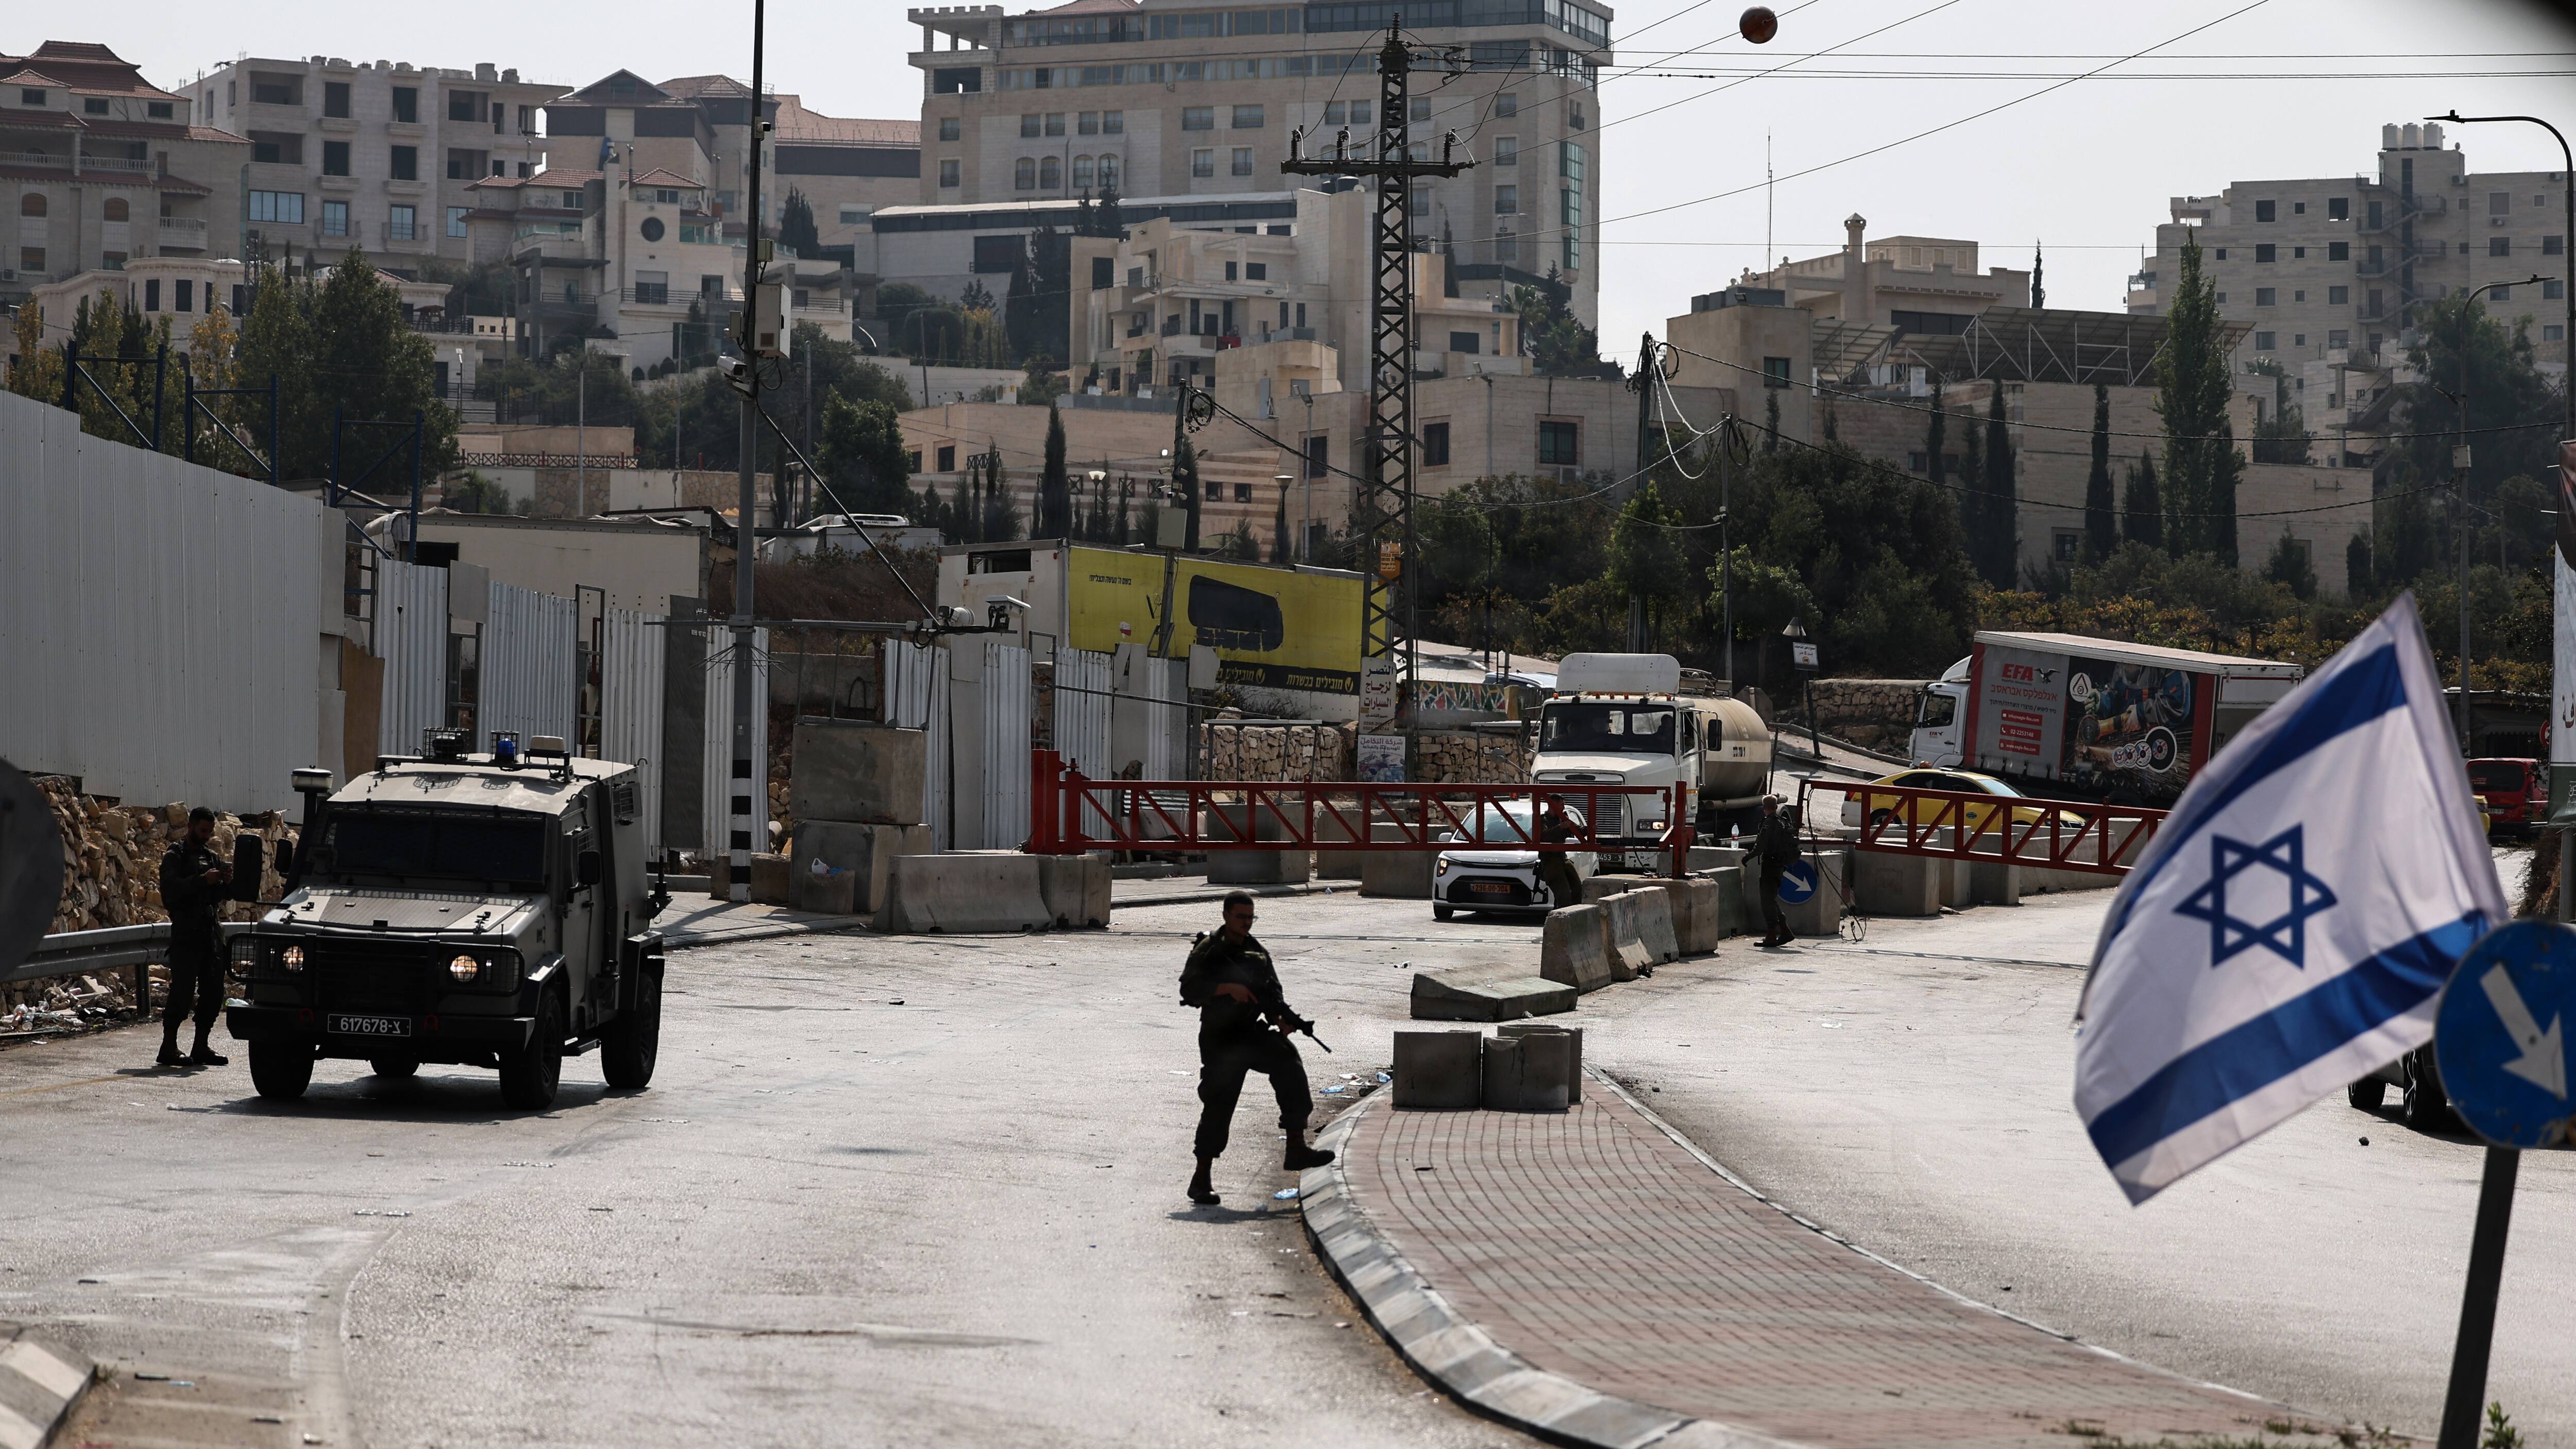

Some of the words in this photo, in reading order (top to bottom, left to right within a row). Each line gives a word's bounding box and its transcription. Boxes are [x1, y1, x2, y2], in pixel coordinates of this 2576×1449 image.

[1365, 664, 1393, 677] النصر
[2002, 663, 2033, 681] EFA
[1286, 674, 1314, 687] בכשרות
[1316, 676, 1344, 690] מובילים
[1365, 680, 1391, 694] لزجاج
[1364, 697, 1391, 710] السيارات
[2010, 729, 2034, 737] 02-2253148
[1476, 884, 1508, 892] 296-00-304
